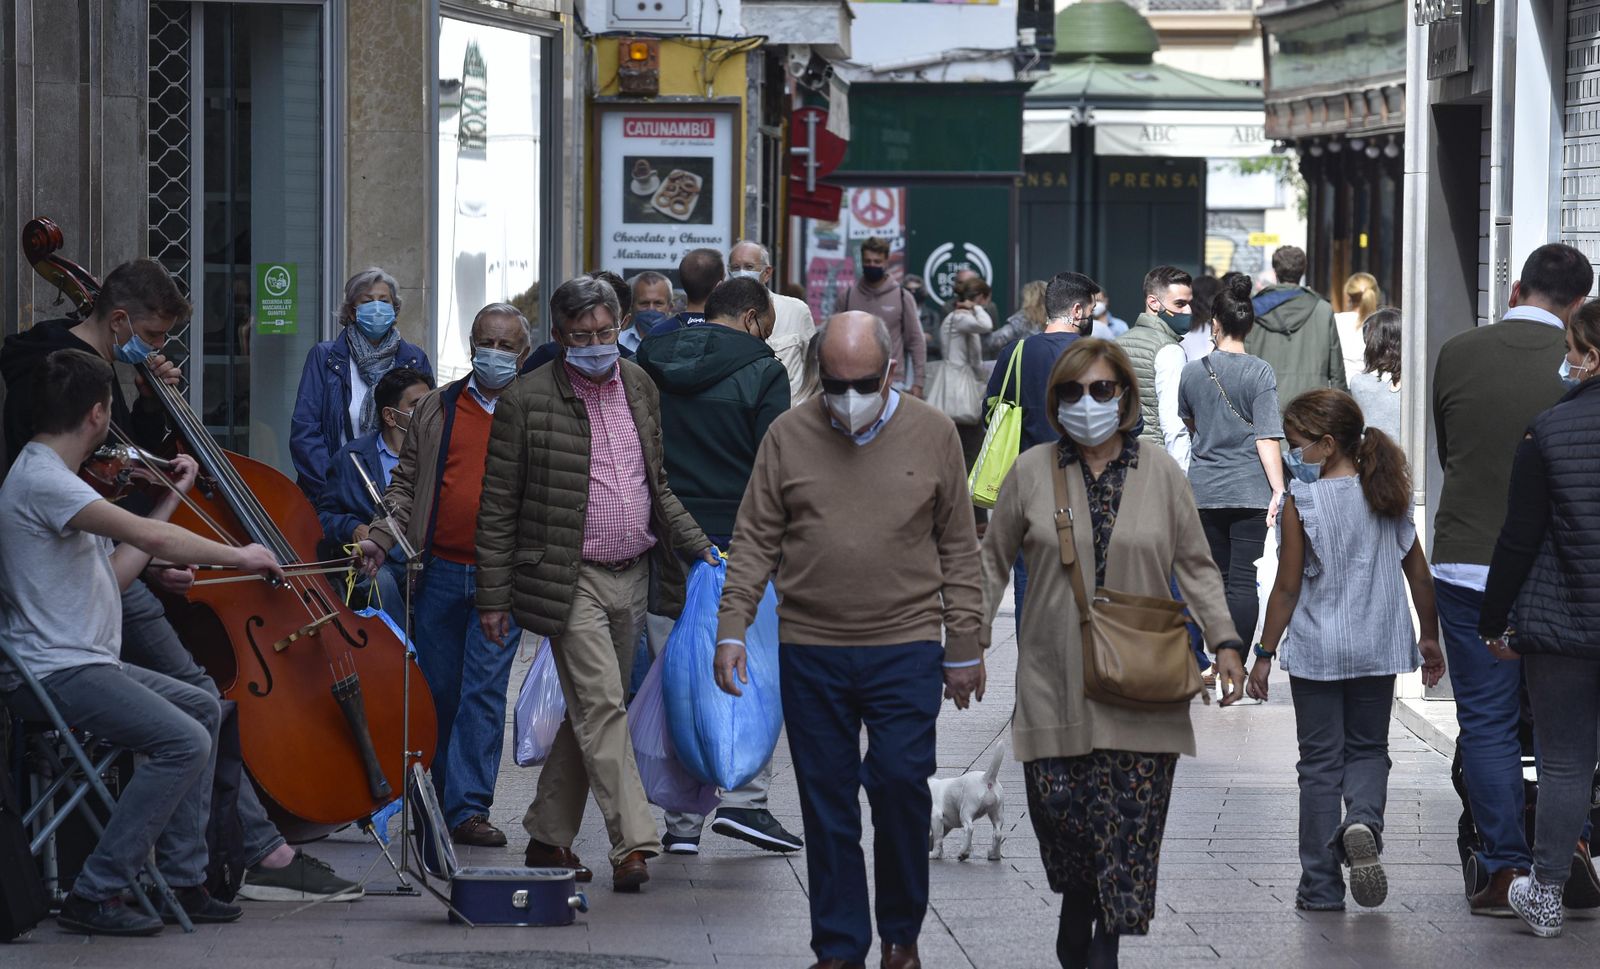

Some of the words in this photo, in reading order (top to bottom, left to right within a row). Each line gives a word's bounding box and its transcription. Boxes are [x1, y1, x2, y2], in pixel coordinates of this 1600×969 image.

[625, 120, 710, 137] CATUNAMBÚ
[1139, 125, 1177, 142] ABC
[1230, 126, 1265, 142] ABC
[1109, 172, 1199, 188] PRENSA
[613, 231, 665, 244] Chocolate
[667, 236, 676, 246] y
[679, 232, 723, 244] Churros
[612, 249, 667, 260] Mañanas
[670, 252, 678, 263] y
[947, 263, 971, 273] THE
